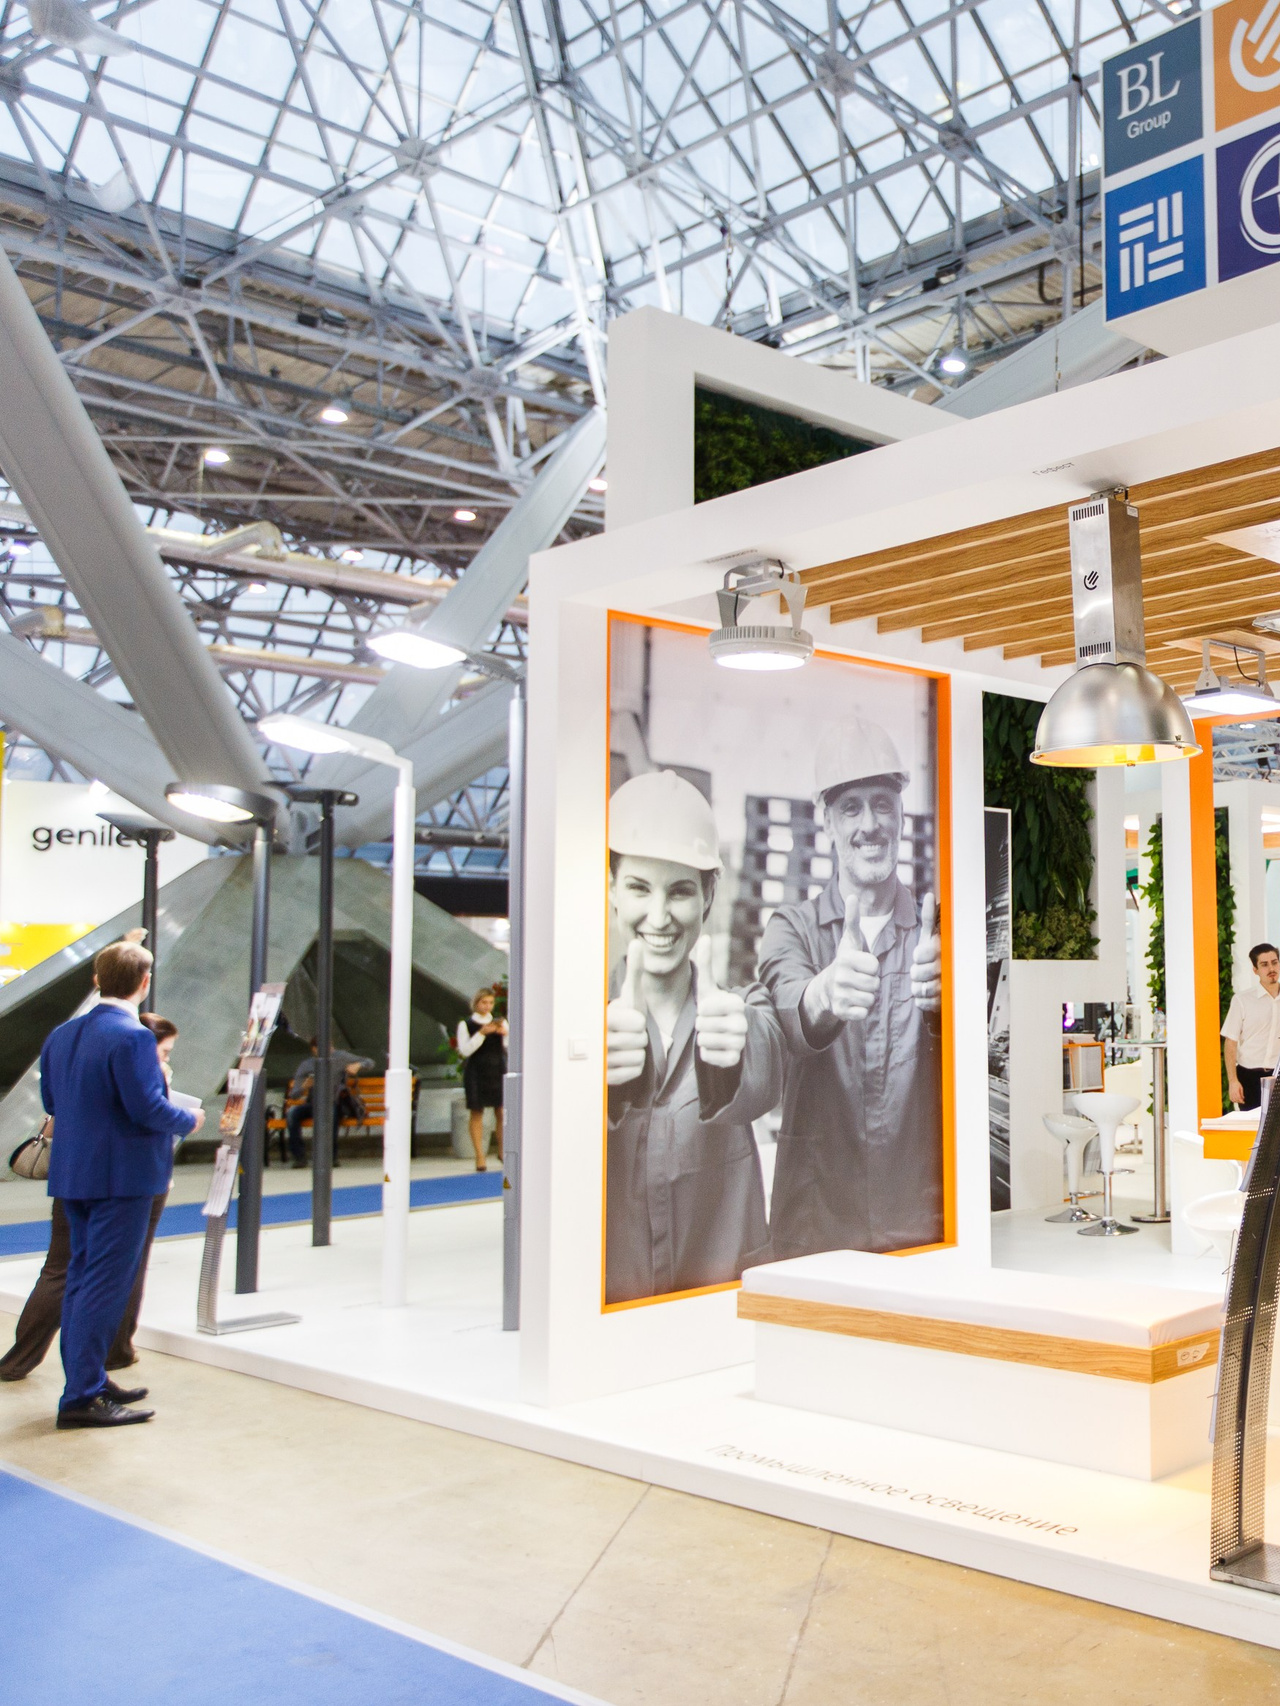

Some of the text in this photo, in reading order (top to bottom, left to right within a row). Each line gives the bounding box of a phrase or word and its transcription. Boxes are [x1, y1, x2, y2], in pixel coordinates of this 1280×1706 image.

[1116, 51, 1181, 120] BL
[1127, 111, 1172, 138] Group
[706, 1444, 1079, 1537] Промышленное освещение
